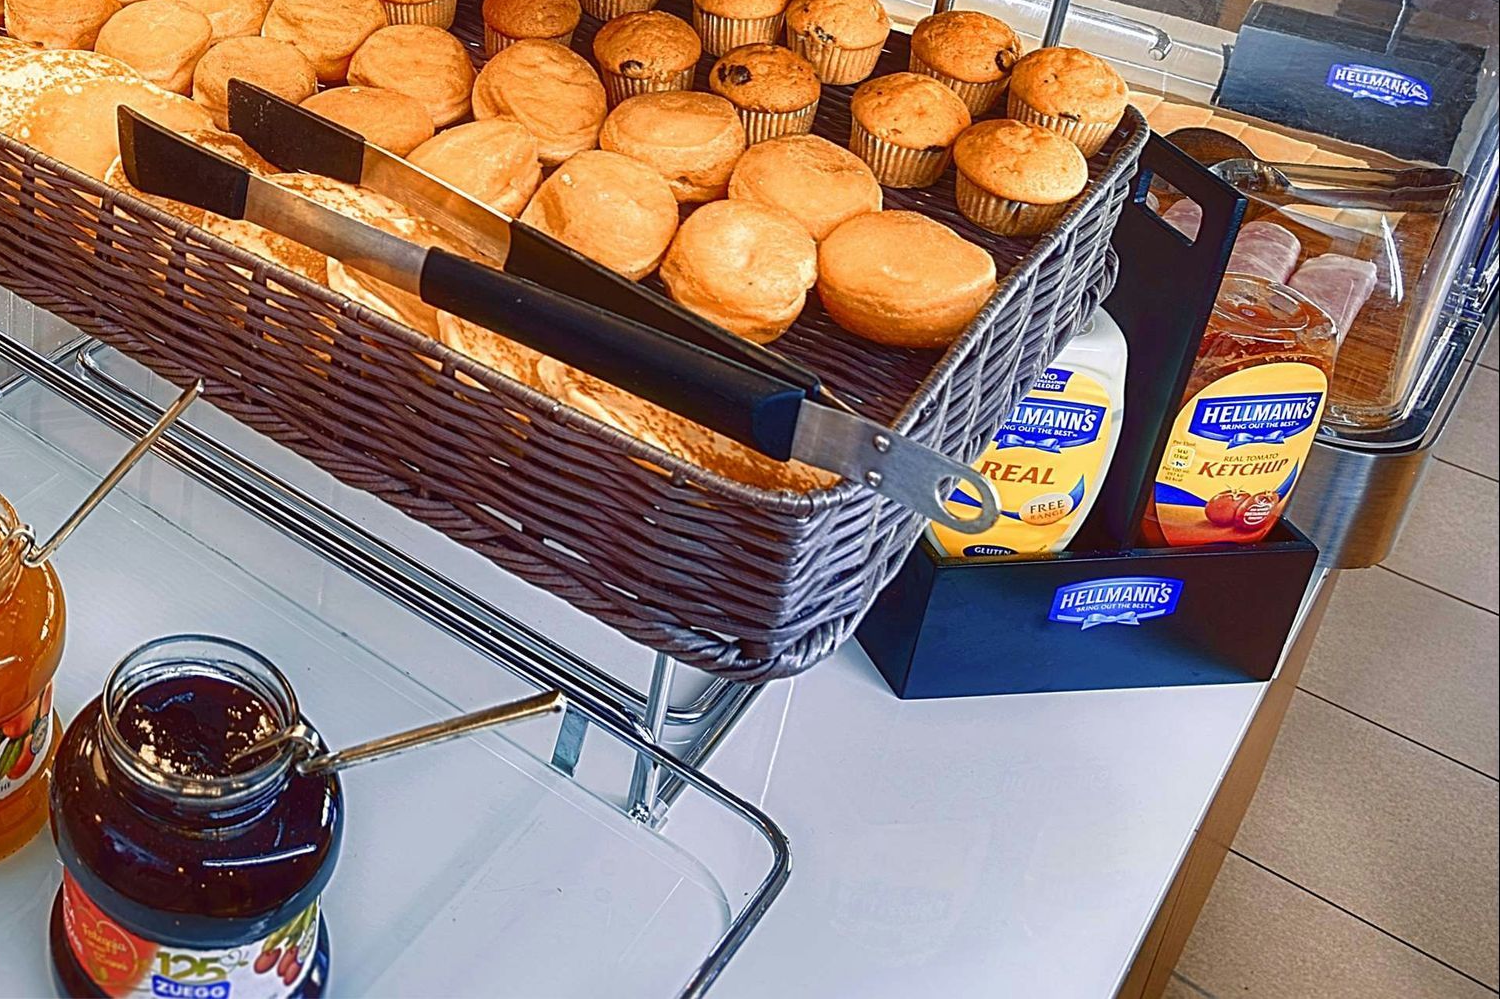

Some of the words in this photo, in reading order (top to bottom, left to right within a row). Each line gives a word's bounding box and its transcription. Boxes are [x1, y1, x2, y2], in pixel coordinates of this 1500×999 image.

[1041, 372, 1058, 381] NO
[1005, 406, 1097, 432] LMANN'S
[1201, 396, 1316, 425] HELLMANN'S
[1018, 425, 1037, 433] OUT
[1037, 427, 1053, 435] THE
[1223, 455, 1246, 463] REAL
[1246, 452, 1279, 462] TOMATO
[979, 460, 1056, 485] REAL
[1197, 458, 1289, 479] KETCHUP
[1029, 499, 1066, 515] FREE
[1029, 508, 1066, 521] RANGE
[1059, 582, 1173, 610] HELLMANN'S
[156, 951, 230, 982] 125
[155, 978, 226, 998] ZUEGG
